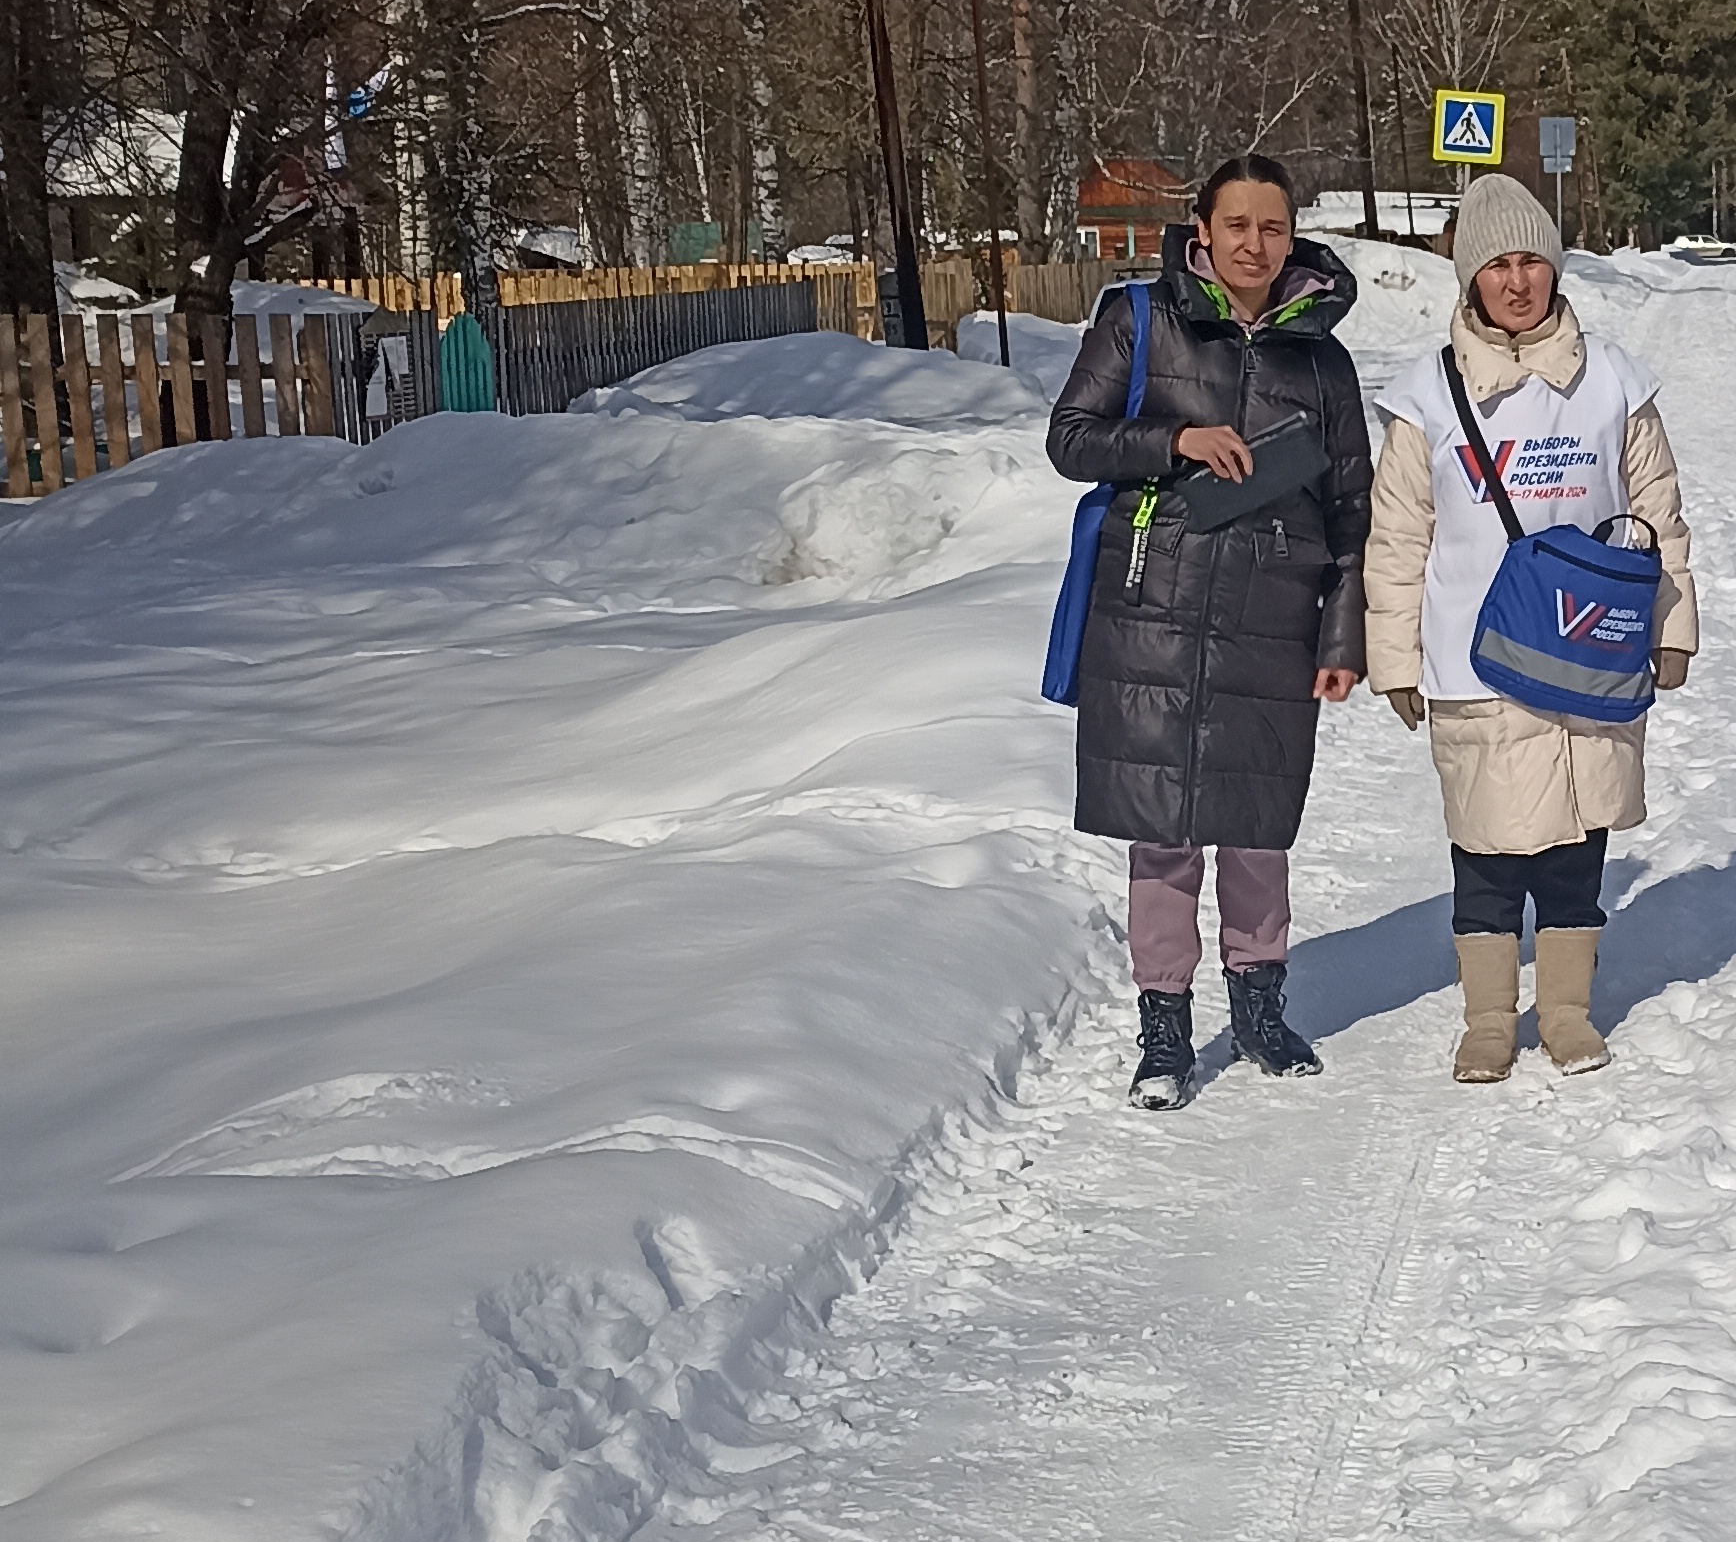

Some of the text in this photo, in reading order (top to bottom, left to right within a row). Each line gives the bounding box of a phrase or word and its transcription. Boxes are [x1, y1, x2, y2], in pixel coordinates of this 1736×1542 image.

[1523, 436, 1582, 452] ВЫБОРЫ
[1516, 452, 1598, 468] ПРЕЗИДЕНТА
[1509, 471, 1564, 486] РОССИИ
[1533, 486, 1565, 499] МАРТА
